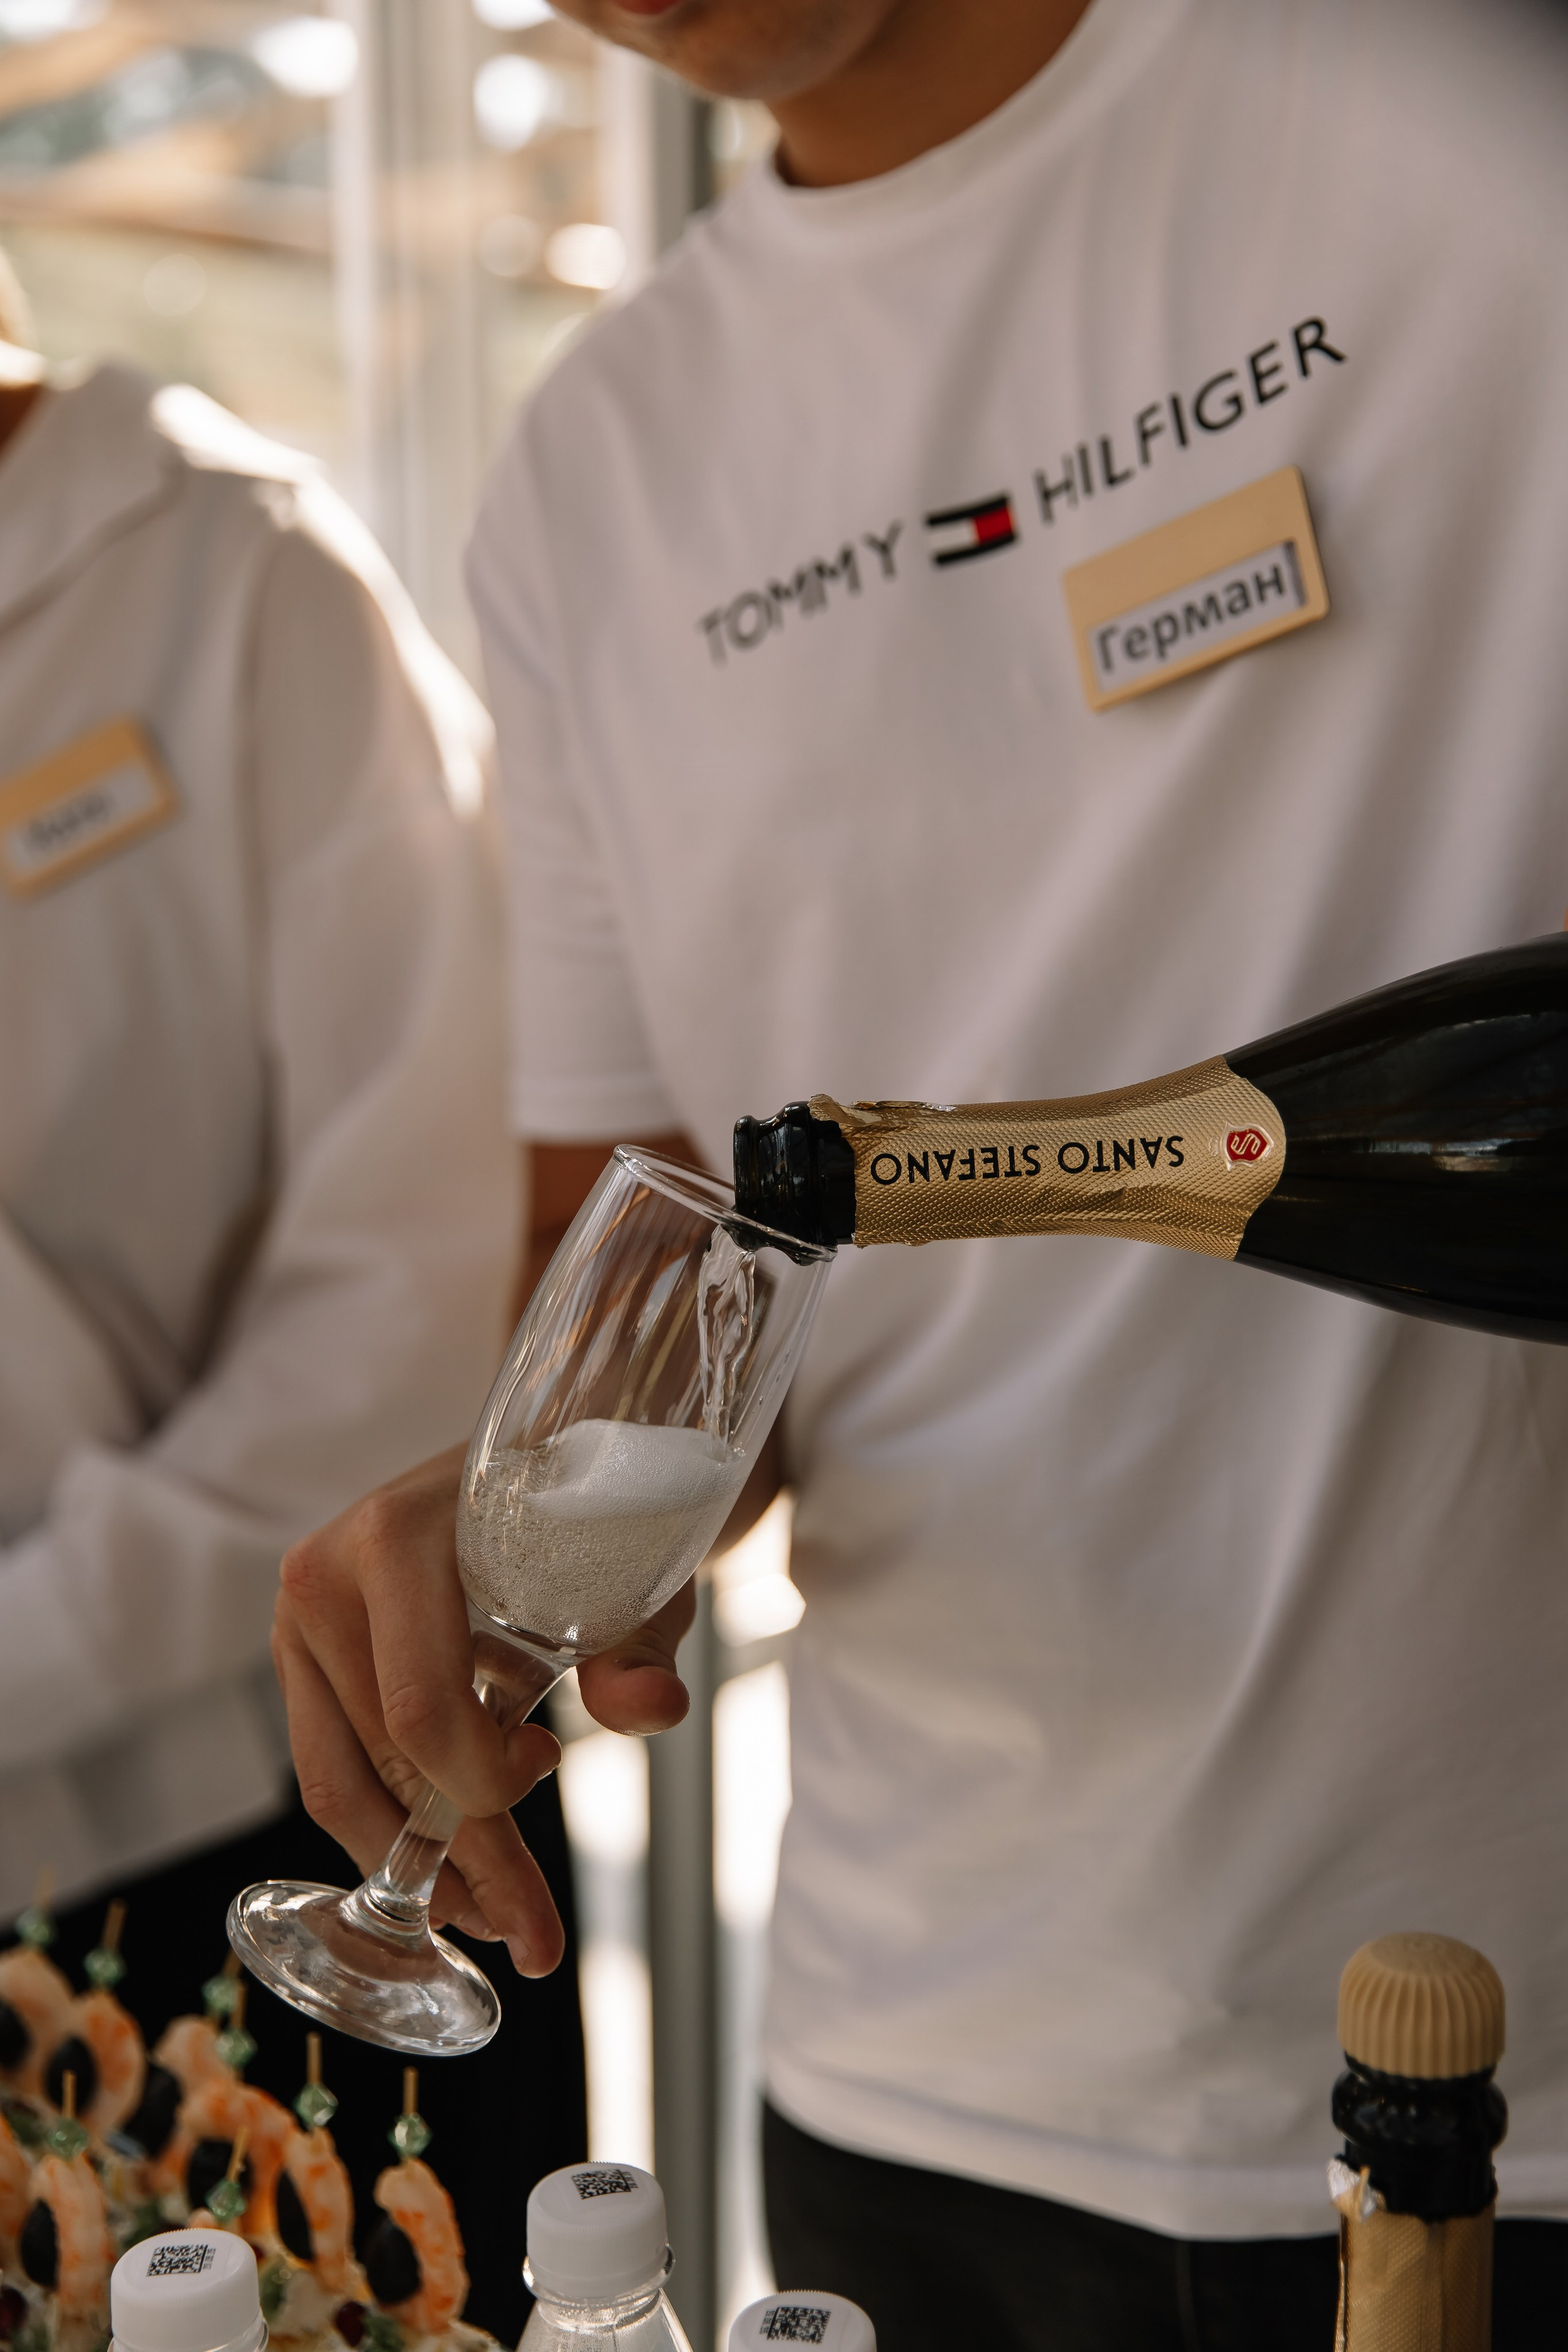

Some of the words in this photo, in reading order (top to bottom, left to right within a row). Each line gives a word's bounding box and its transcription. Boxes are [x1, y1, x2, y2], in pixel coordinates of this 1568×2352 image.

[697, 520, 903, 666] TOMMY
[1033, 316, 1346, 523] HILFIGER
[1098, 564, 1284, 673] Герман
[870, 1144, 1042, 1185] STEFANO
[1057, 1135, 1184, 1174] SANTO
